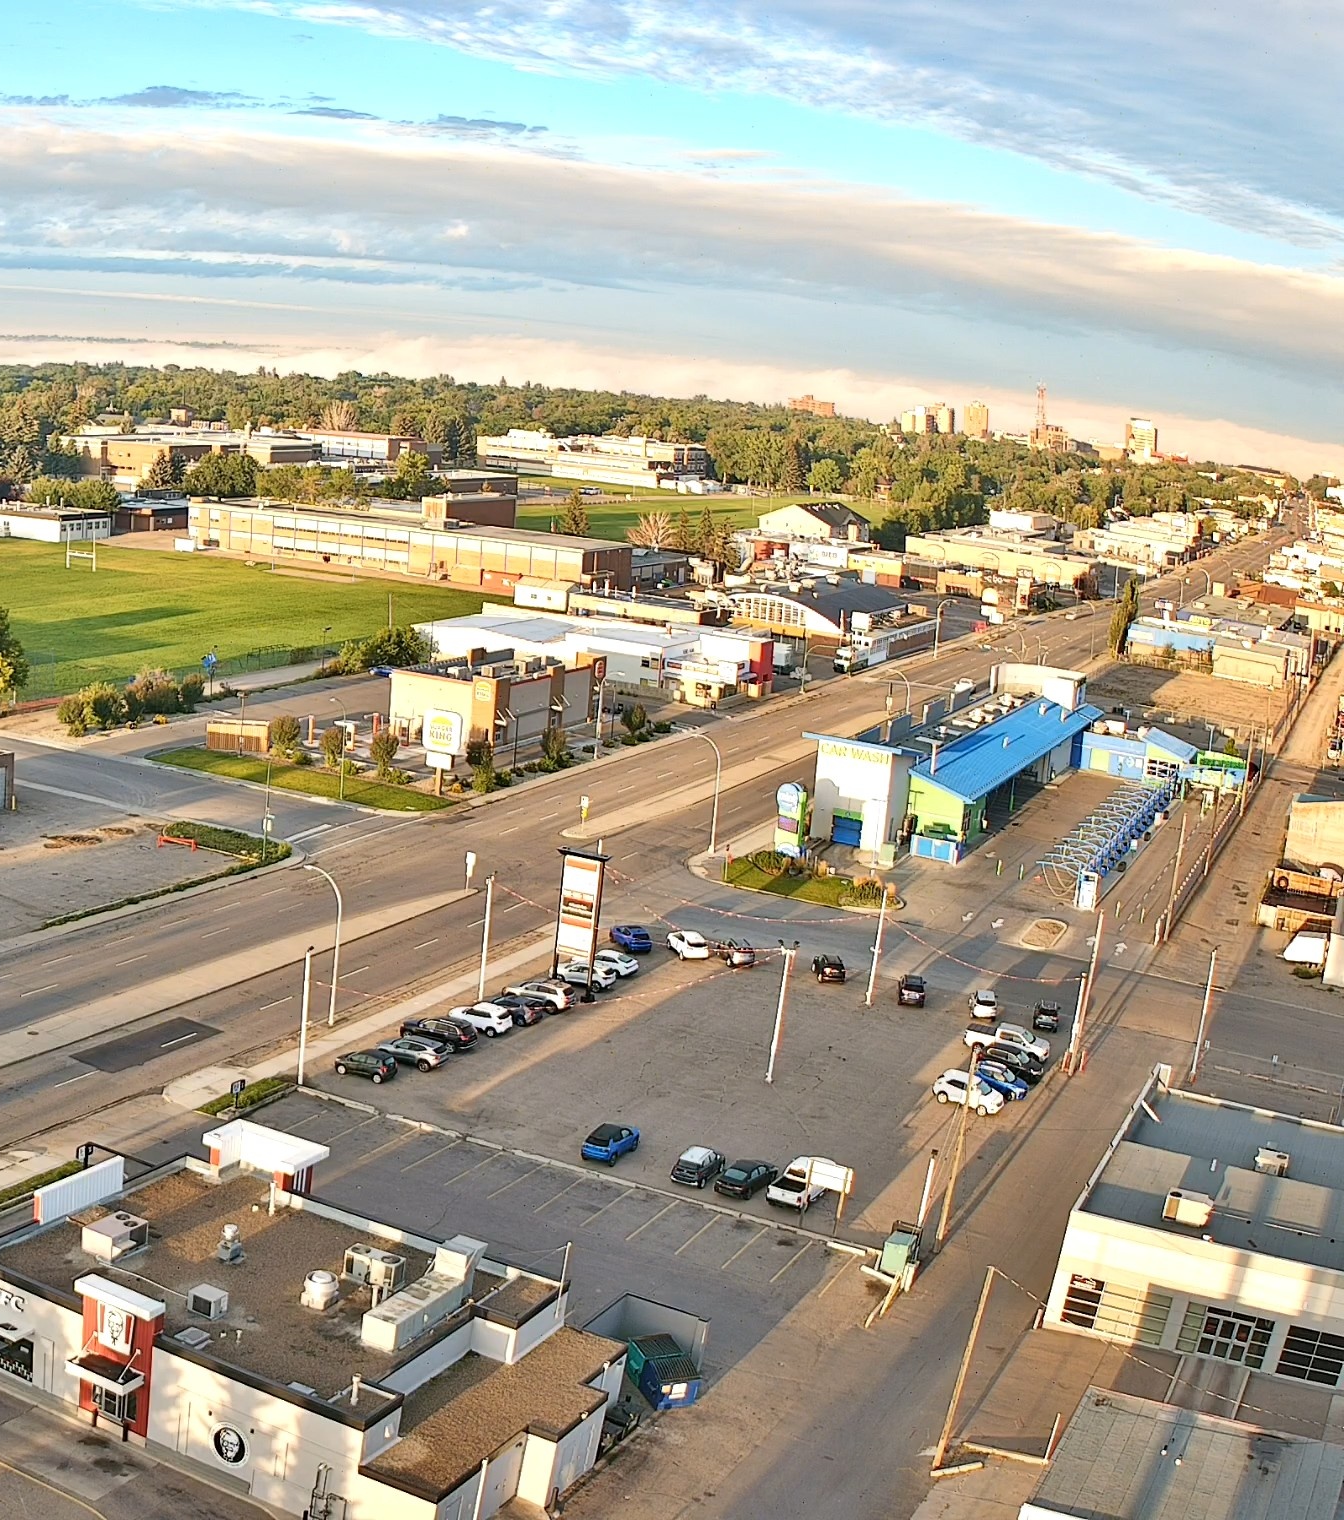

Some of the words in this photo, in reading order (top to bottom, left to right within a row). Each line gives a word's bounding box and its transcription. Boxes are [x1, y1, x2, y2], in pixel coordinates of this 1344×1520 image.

[429, 730, 452, 741] KING
[821, 743, 847, 757] CAR
[851, 747, 889, 765] WASH
